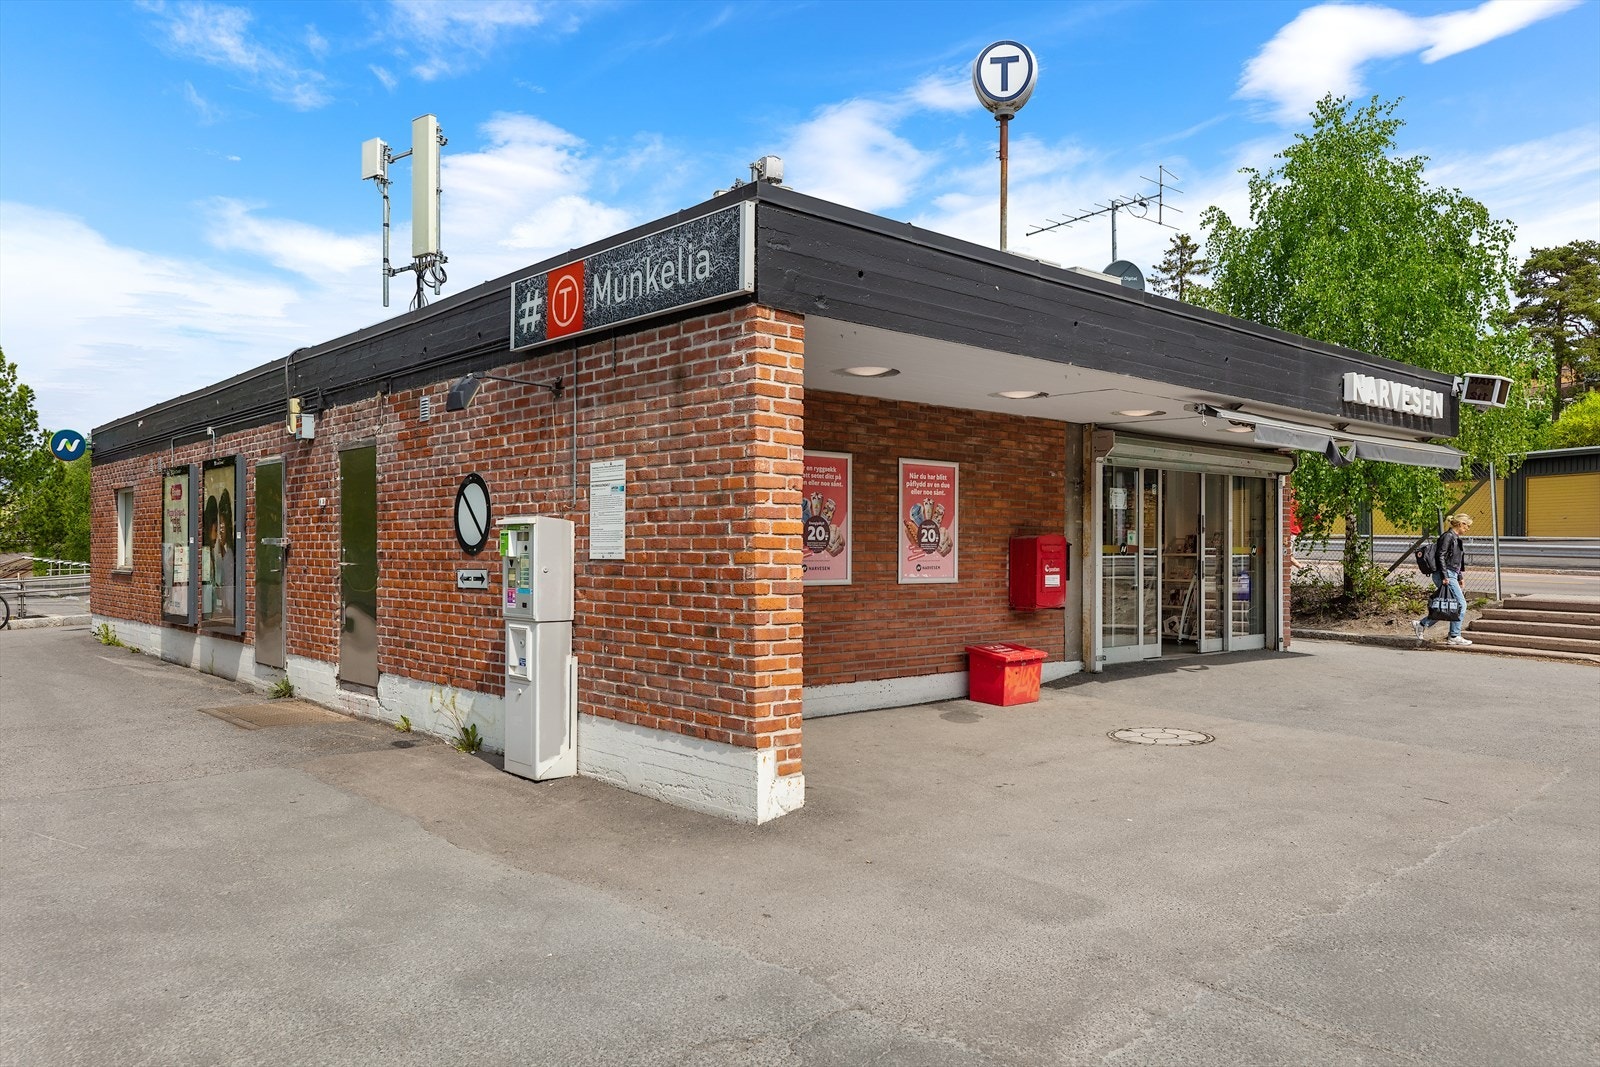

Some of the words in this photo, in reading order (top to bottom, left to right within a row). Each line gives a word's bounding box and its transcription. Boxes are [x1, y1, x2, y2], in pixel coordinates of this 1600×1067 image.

[990, 55, 1019, 91] T
[593, 243, 710, 309] Munkelia
[1344, 372, 1443, 419] NARVESEN
